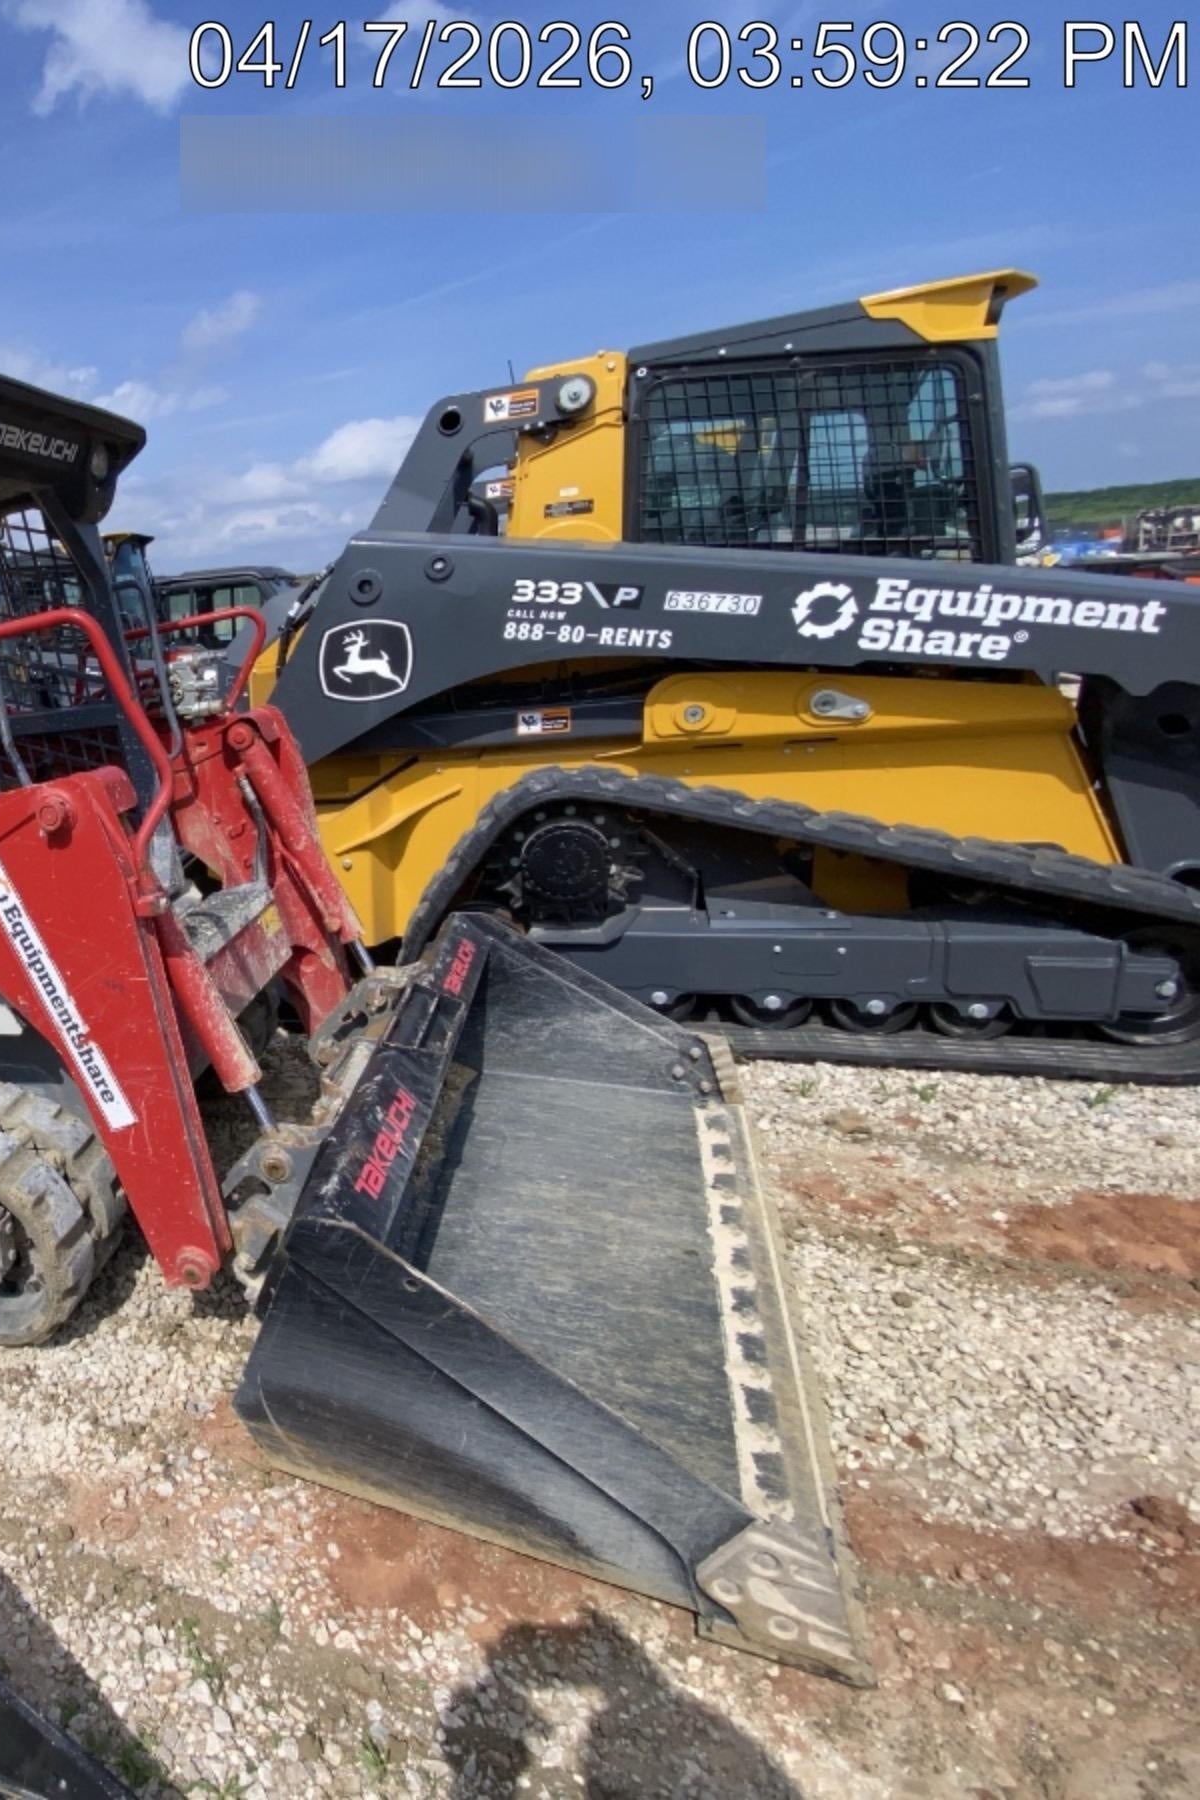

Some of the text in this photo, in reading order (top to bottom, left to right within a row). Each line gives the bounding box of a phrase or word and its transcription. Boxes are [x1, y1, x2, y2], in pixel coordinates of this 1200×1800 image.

[512, 579, 584, 605] 333
[667, 592, 759, 615] 636730
[869, 577, 1167, 634] Equipment
[507, 608, 567, 621] CALL NOW
[503, 621, 673, 650] 888-80-RENTS
[353, 1087, 417, 1201] TAKEUCHI
